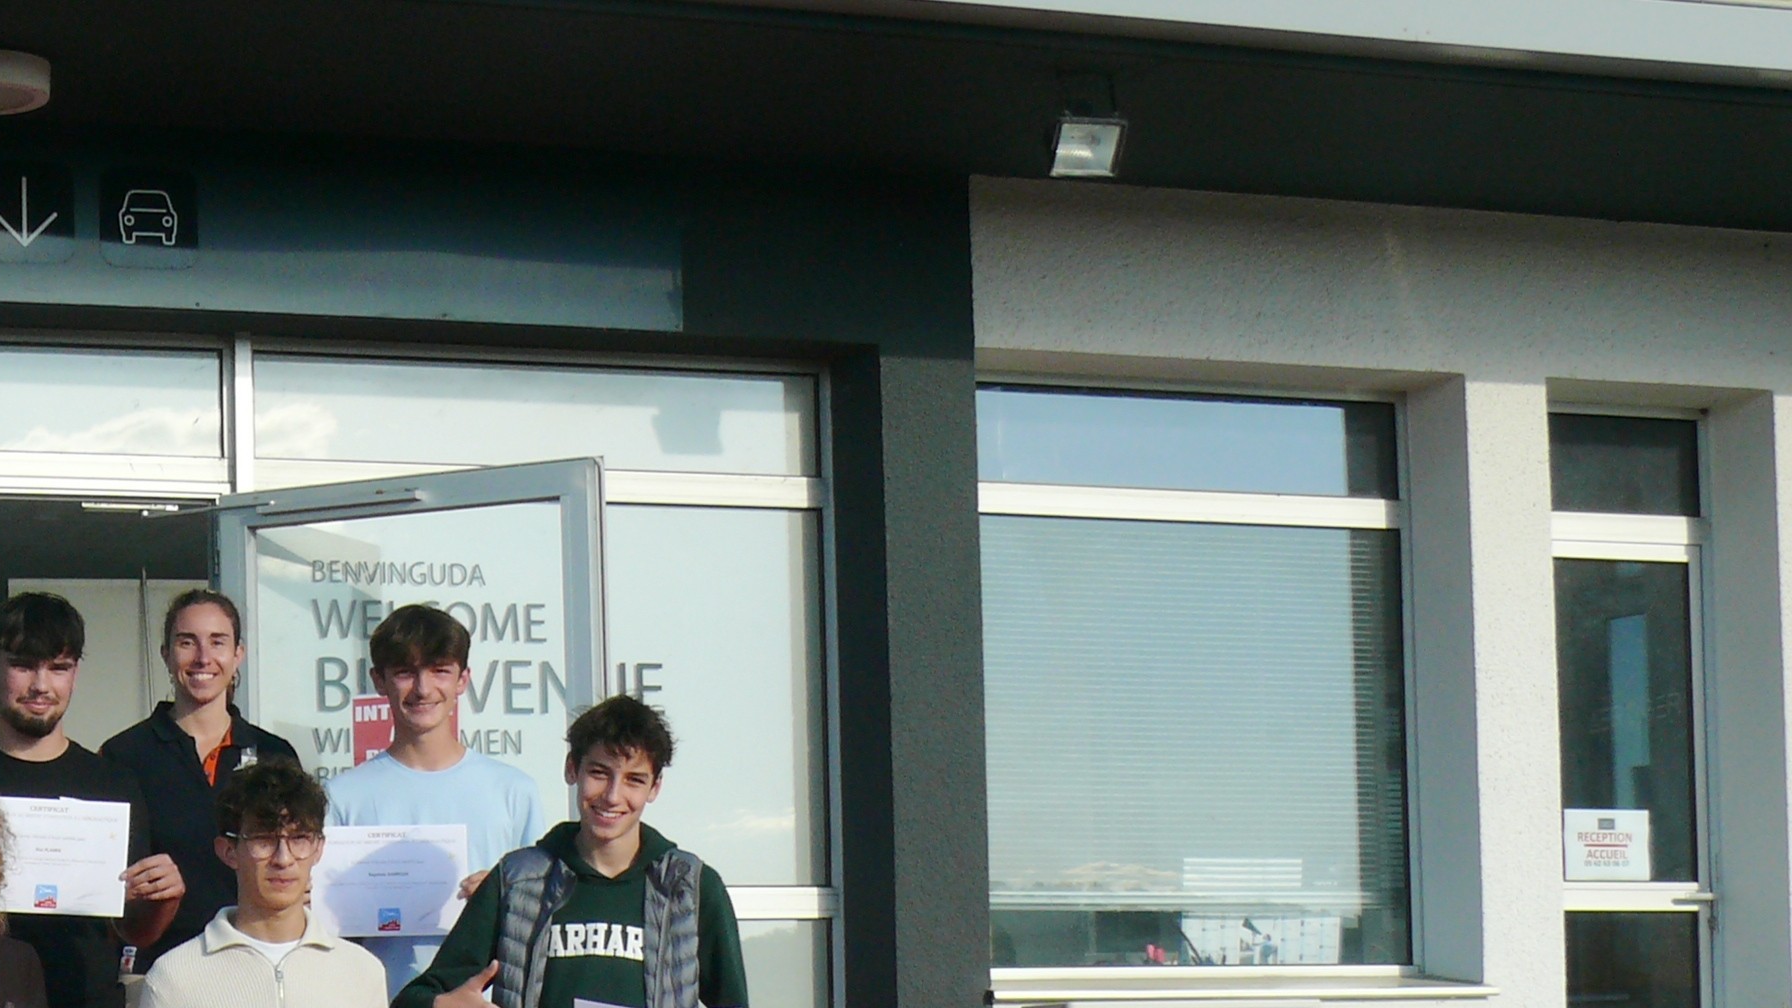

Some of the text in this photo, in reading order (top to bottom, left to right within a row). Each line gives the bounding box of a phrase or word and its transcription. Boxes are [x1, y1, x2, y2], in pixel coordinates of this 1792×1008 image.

[311, 560, 487, 587] BENVINGUDA
[311, 598, 547, 643] WEOME
[316, 656, 665, 716] BIVENE
[1577, 832, 1633, 843] RECEPTION
[1586, 849, 1628, 860] ACCUEIL
